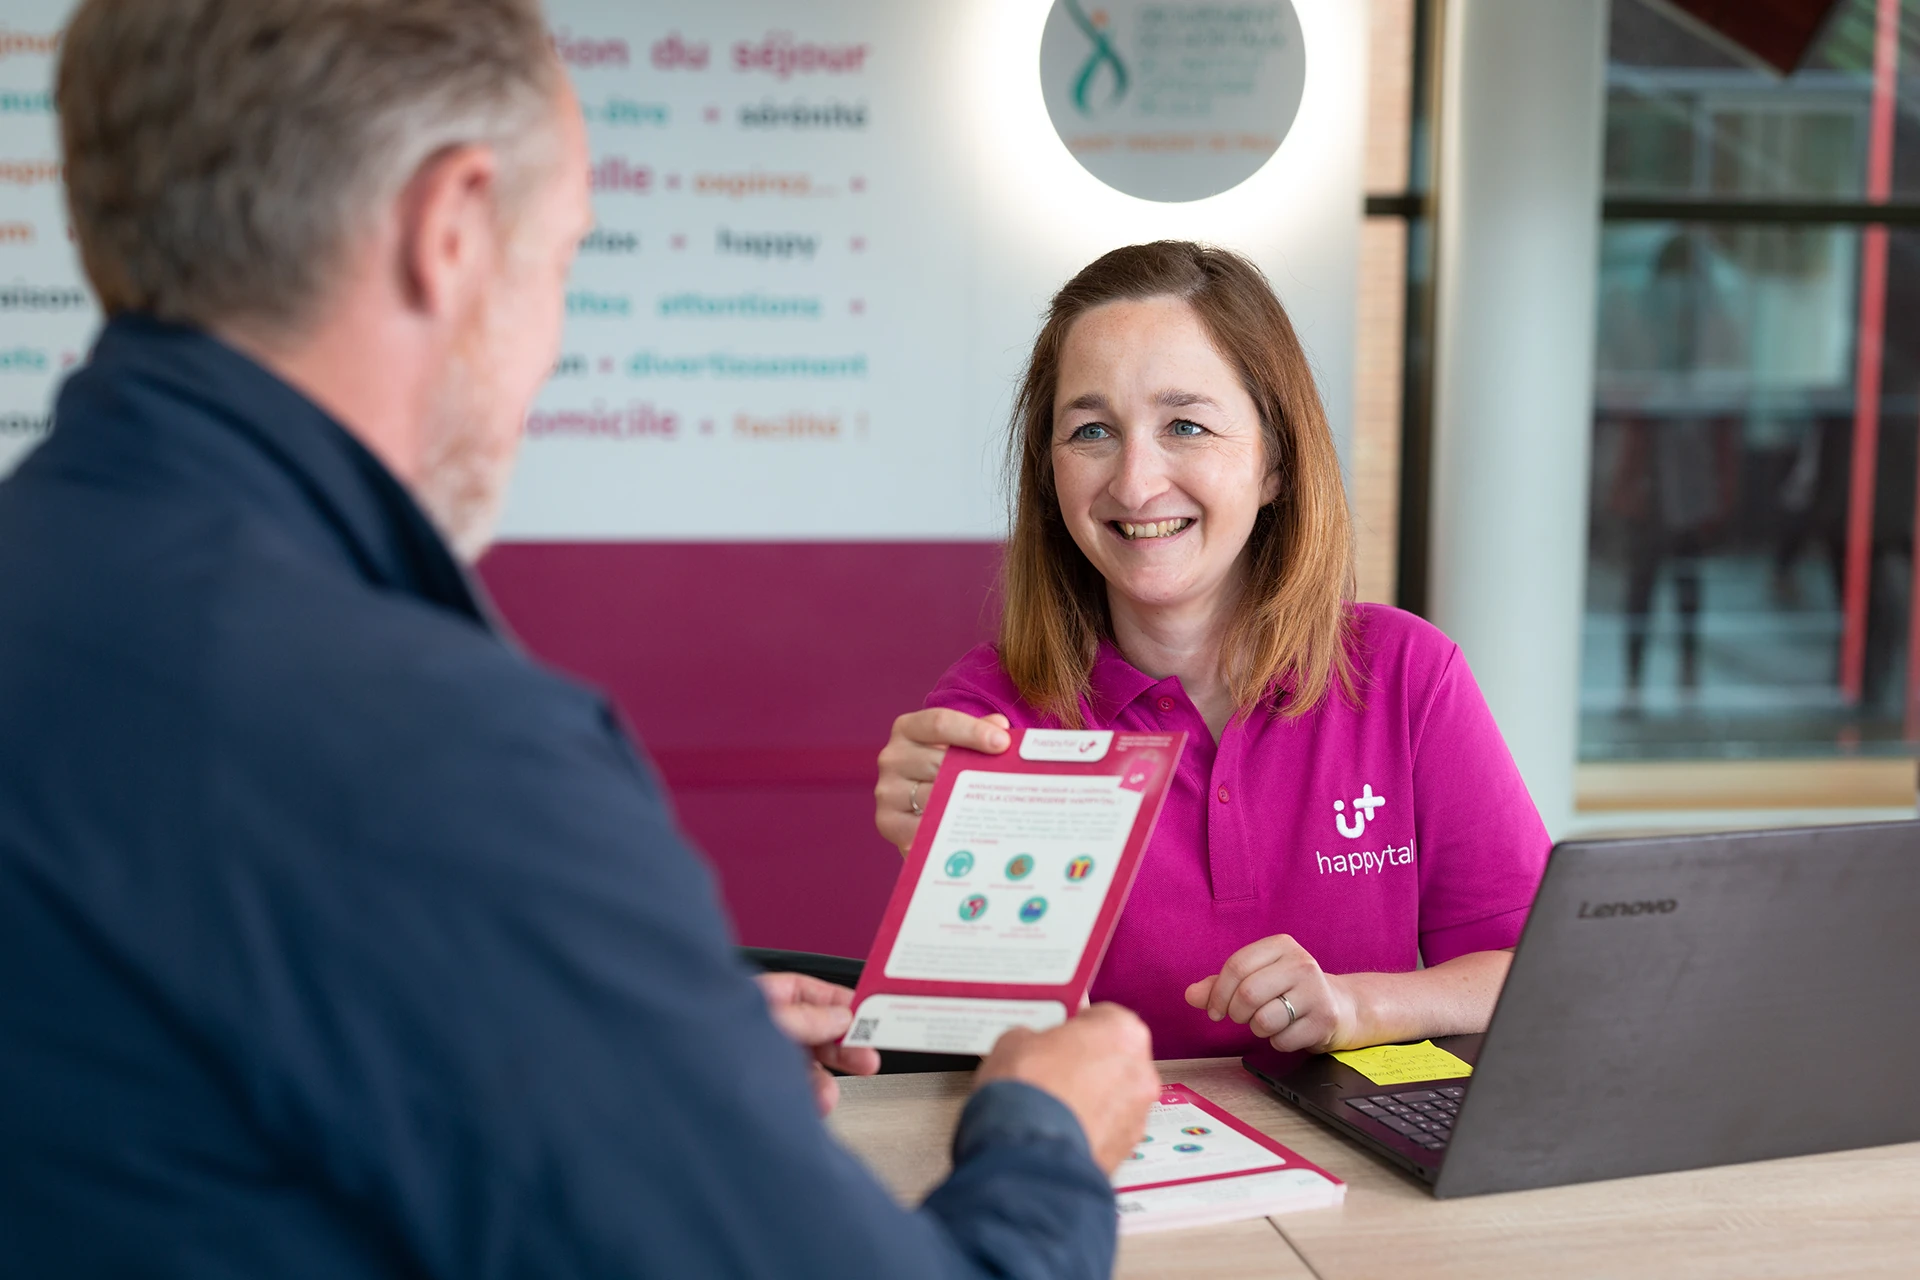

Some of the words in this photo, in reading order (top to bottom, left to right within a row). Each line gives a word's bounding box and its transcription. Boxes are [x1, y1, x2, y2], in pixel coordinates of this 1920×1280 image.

[651, 30, 710, 70] du
[732, 29, 868, 79] séjour
[1316, 838, 1414, 876] happytal
[1576, 898, 1679, 919] Lenovo
